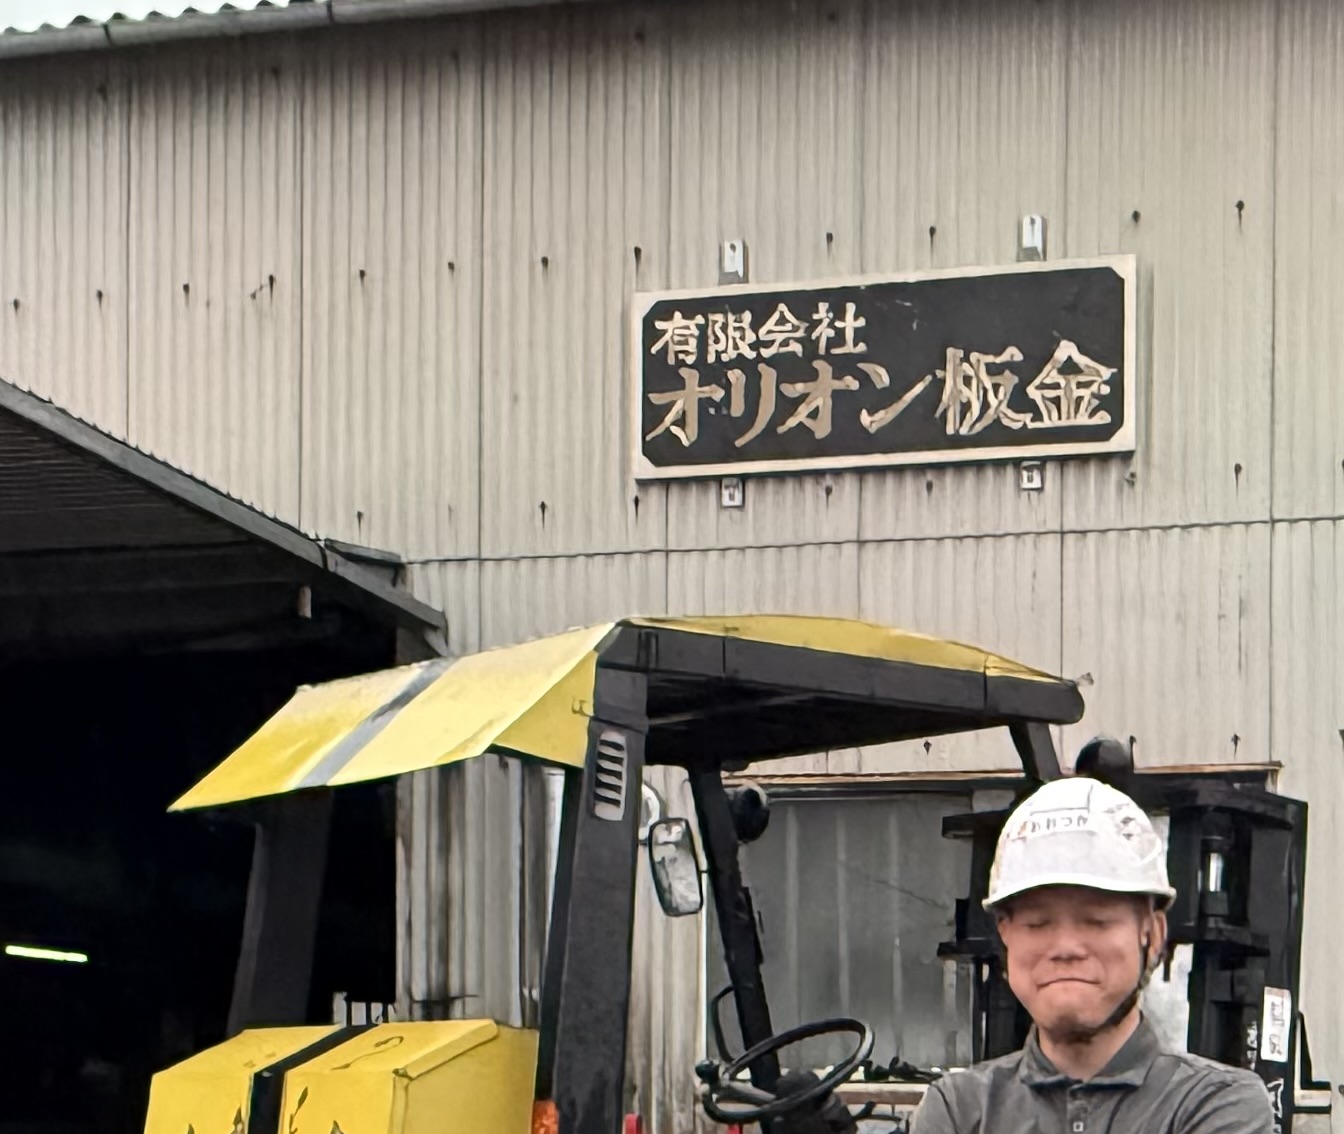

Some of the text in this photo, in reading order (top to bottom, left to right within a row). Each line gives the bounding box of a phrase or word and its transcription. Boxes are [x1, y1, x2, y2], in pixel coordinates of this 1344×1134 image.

[650, 302, 867, 365] 有限会社
[645, 339, 1118, 447] オリオン板金
